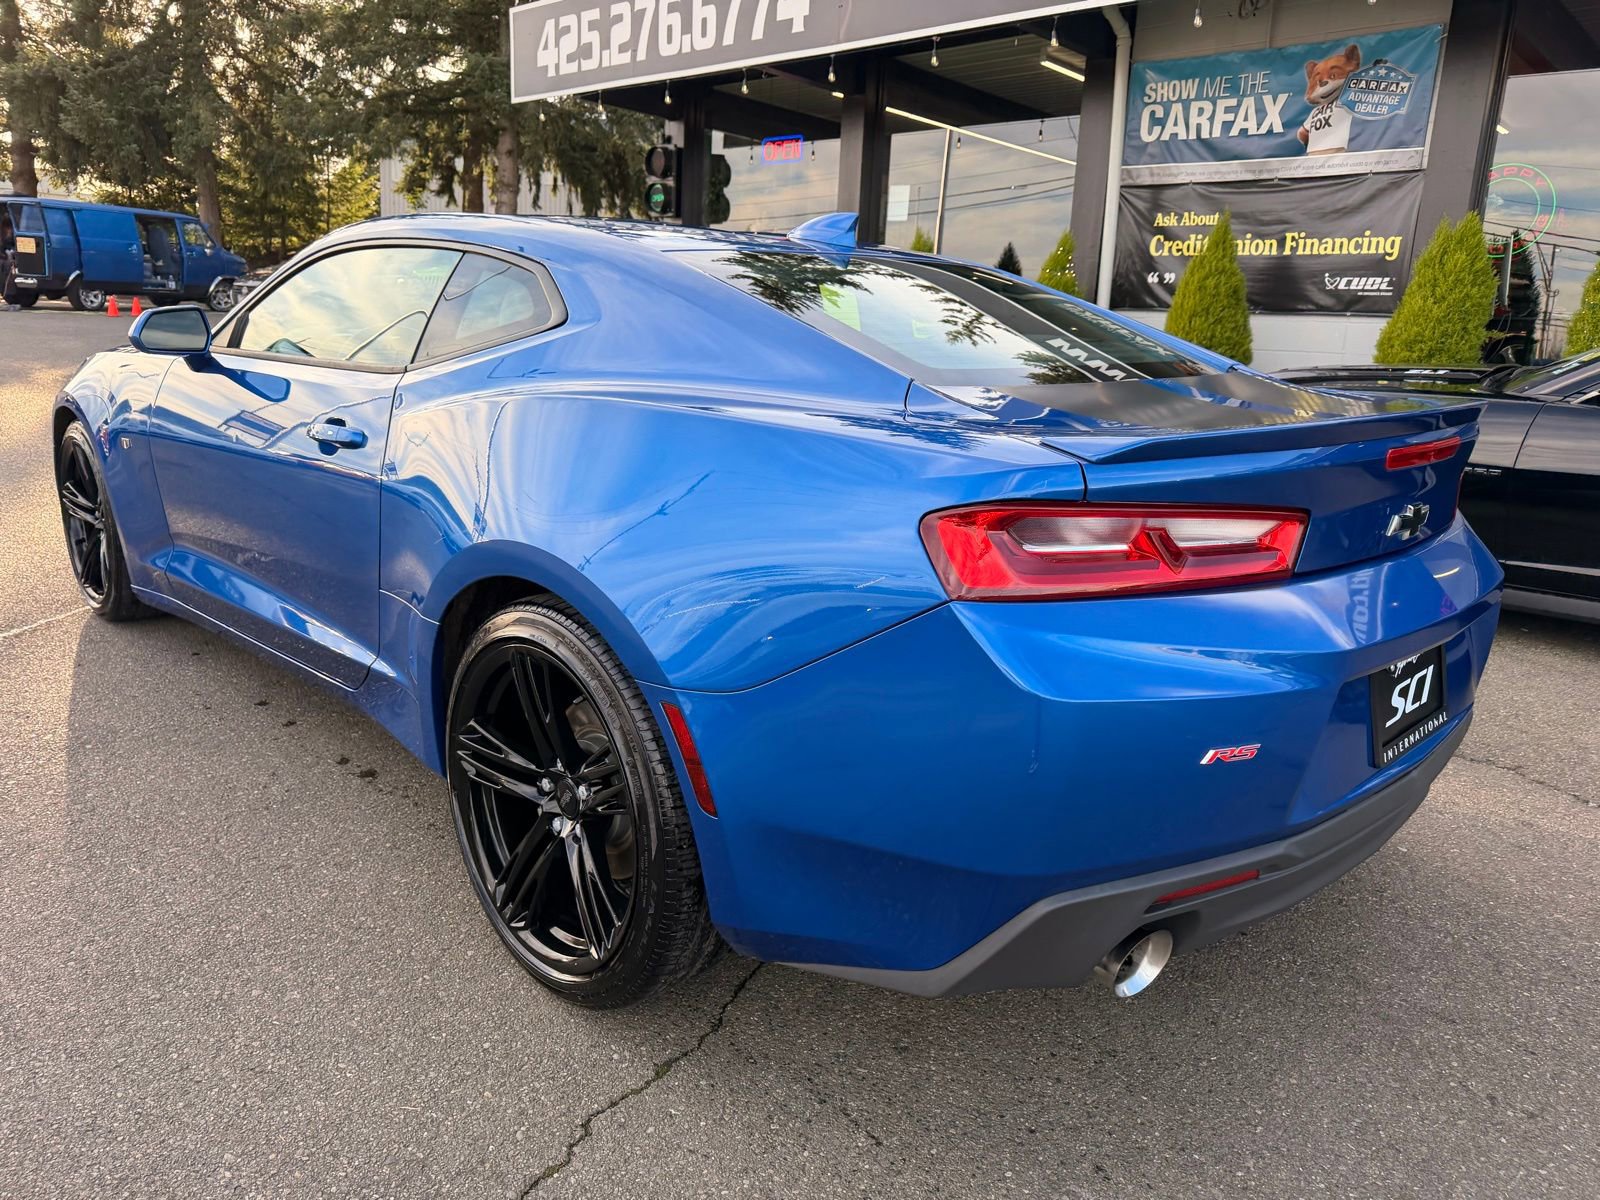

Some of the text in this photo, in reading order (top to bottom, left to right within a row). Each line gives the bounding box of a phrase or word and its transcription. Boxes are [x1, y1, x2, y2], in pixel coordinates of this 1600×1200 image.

[1143, 70, 1271, 103] SHOW ME THE
[1348, 79, 1408, 94] CARFAX
[1347, 92, 1400, 105] ADVANTAGE
[1354, 103, 1389, 115] DEALER
[1140, 93, 1289, 143] CARFAX
[1309, 115, 1332, 133] FOX
[763, 140, 801, 162] OPEN
[1153, 210, 1220, 228] Ask About
[1234, 233, 1278, 257] nion
[1283, 229, 1402, 262] Financing
[1385, 664, 1434, 728] SCI
[1383, 711, 1448, 763] INTERNATIONAL
[1200, 743, 1261, 765] RS
